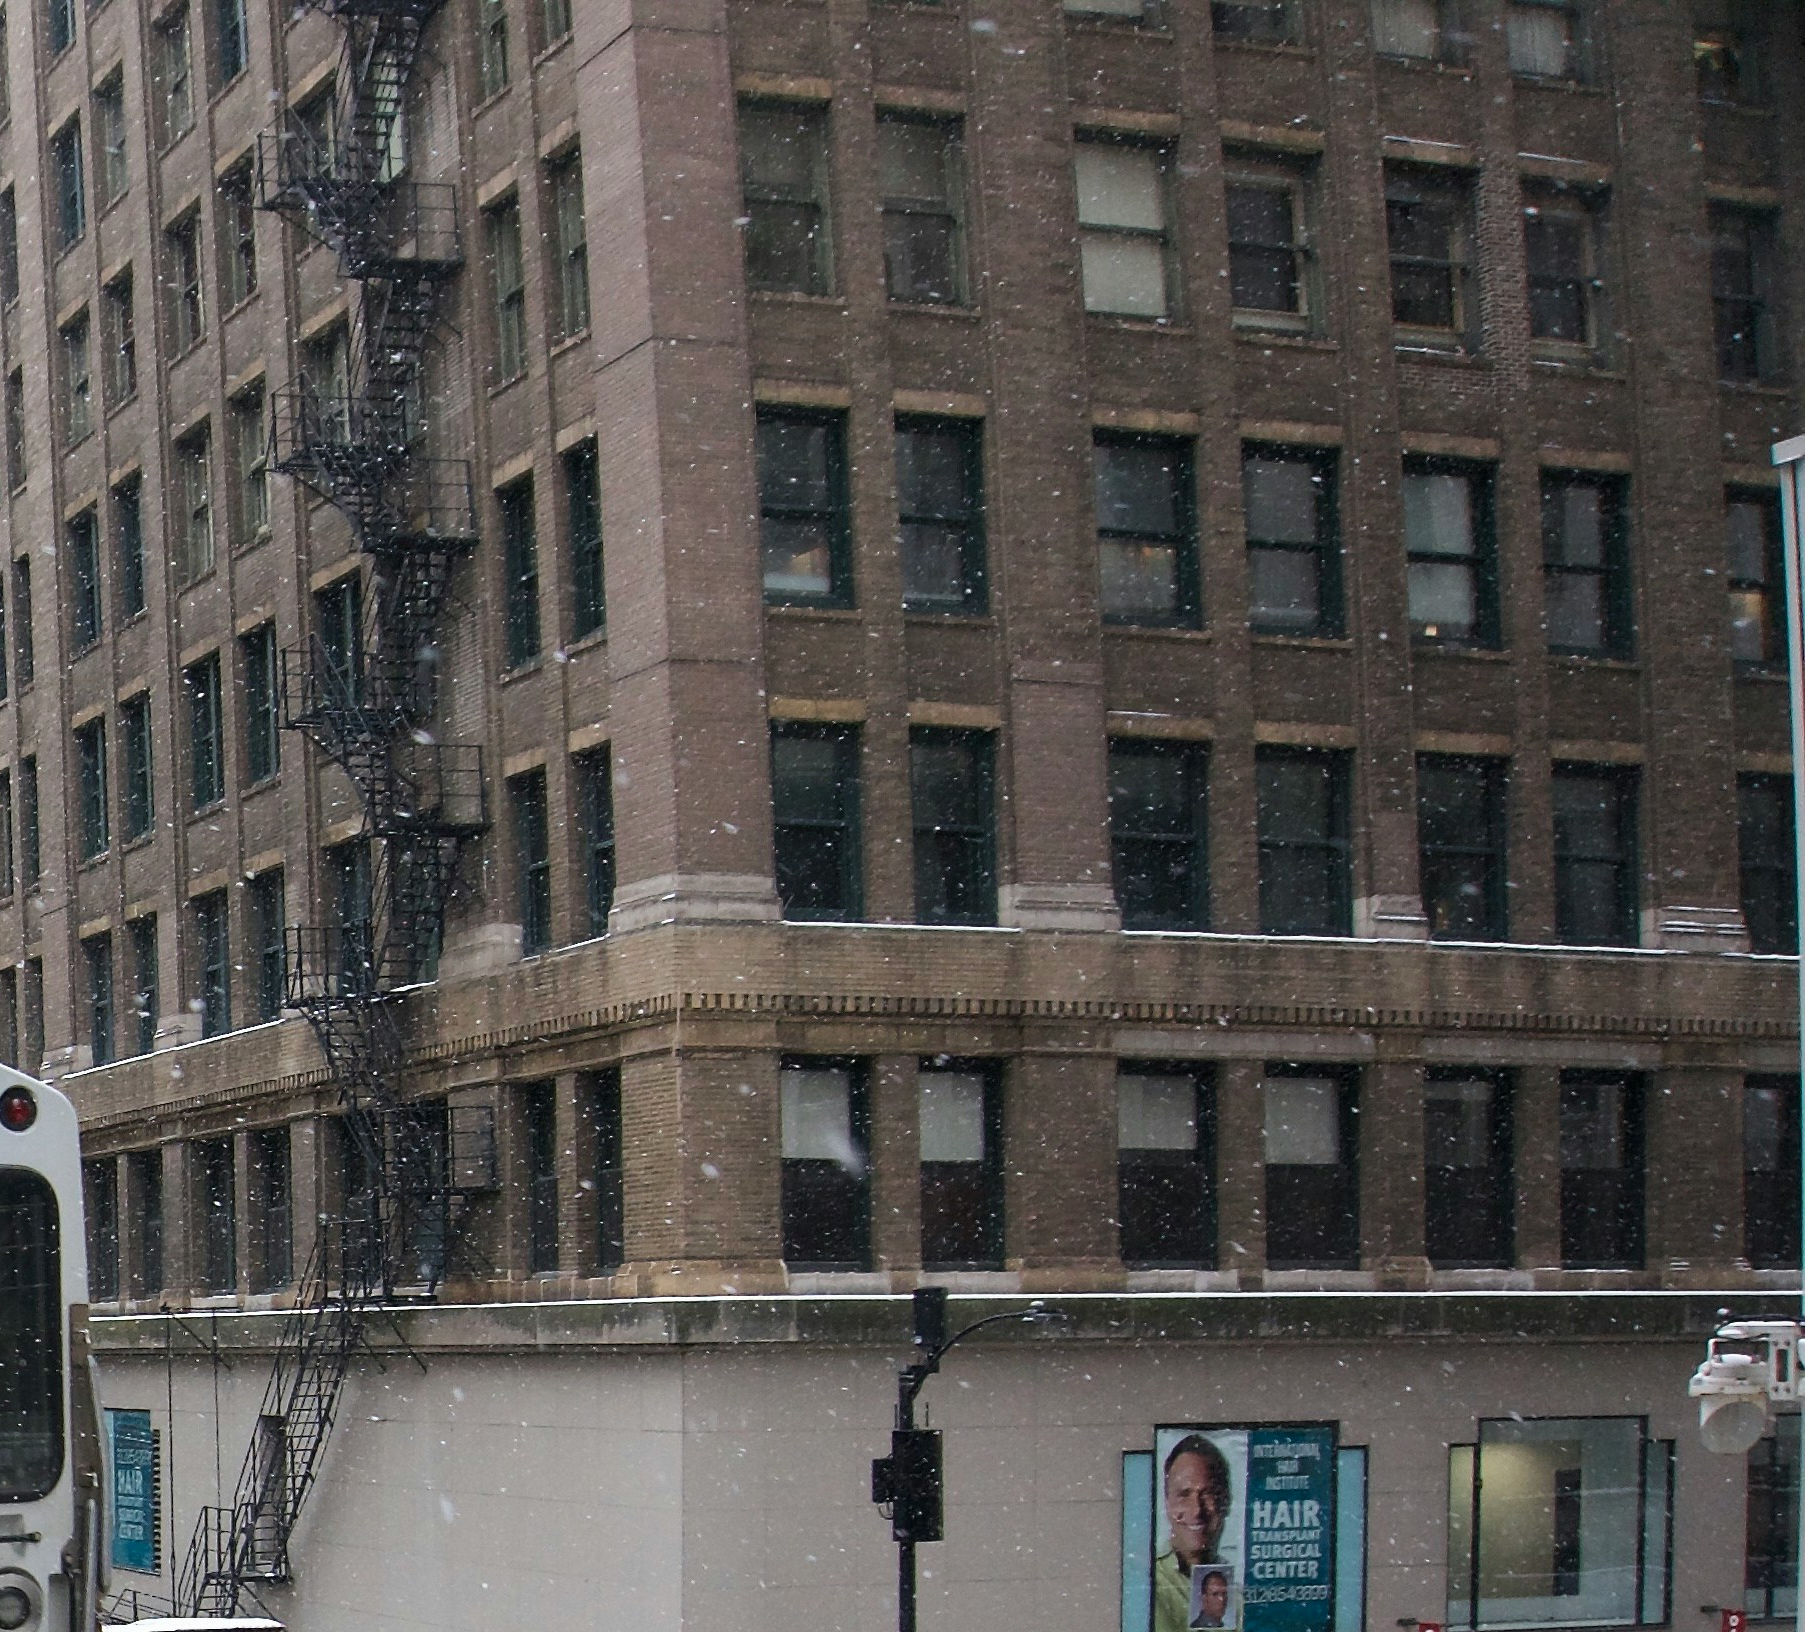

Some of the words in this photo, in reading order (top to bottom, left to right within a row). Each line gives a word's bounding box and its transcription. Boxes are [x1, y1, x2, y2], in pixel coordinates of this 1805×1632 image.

[117, 1469, 144, 1495] HAIR
[1253, 1500, 1321, 1529] HAIR
[1251, 1529, 1321, 1542] TRANSPLANT
[1250, 1543, 1322, 1559] SURGICAL
[1254, 1560, 1319, 1579] CENTER
